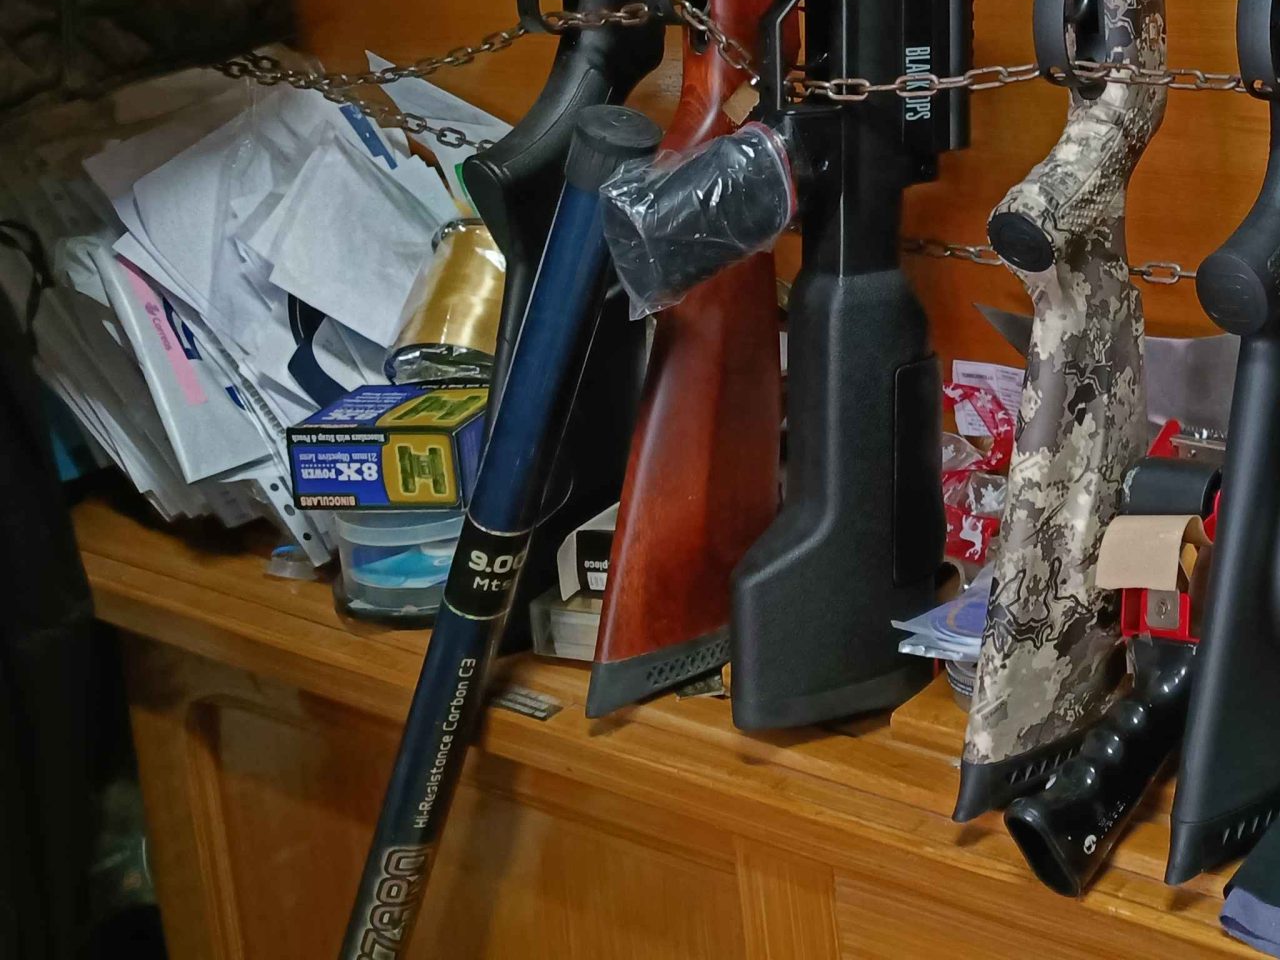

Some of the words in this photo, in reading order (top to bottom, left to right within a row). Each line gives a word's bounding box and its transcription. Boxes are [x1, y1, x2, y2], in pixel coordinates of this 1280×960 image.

[299, 453, 316, 462] Lens
[317, 452, 350, 463] Objective
[351, 452, 378, 462] 21mm
[302, 468, 336, 479] POWER
[337, 463, 379, 482] 8X
[300, 496, 356, 507] BINOCULARS
[414, 734, 454, 830] Hi-Resistance
[443, 682, 468, 733] Carbon
